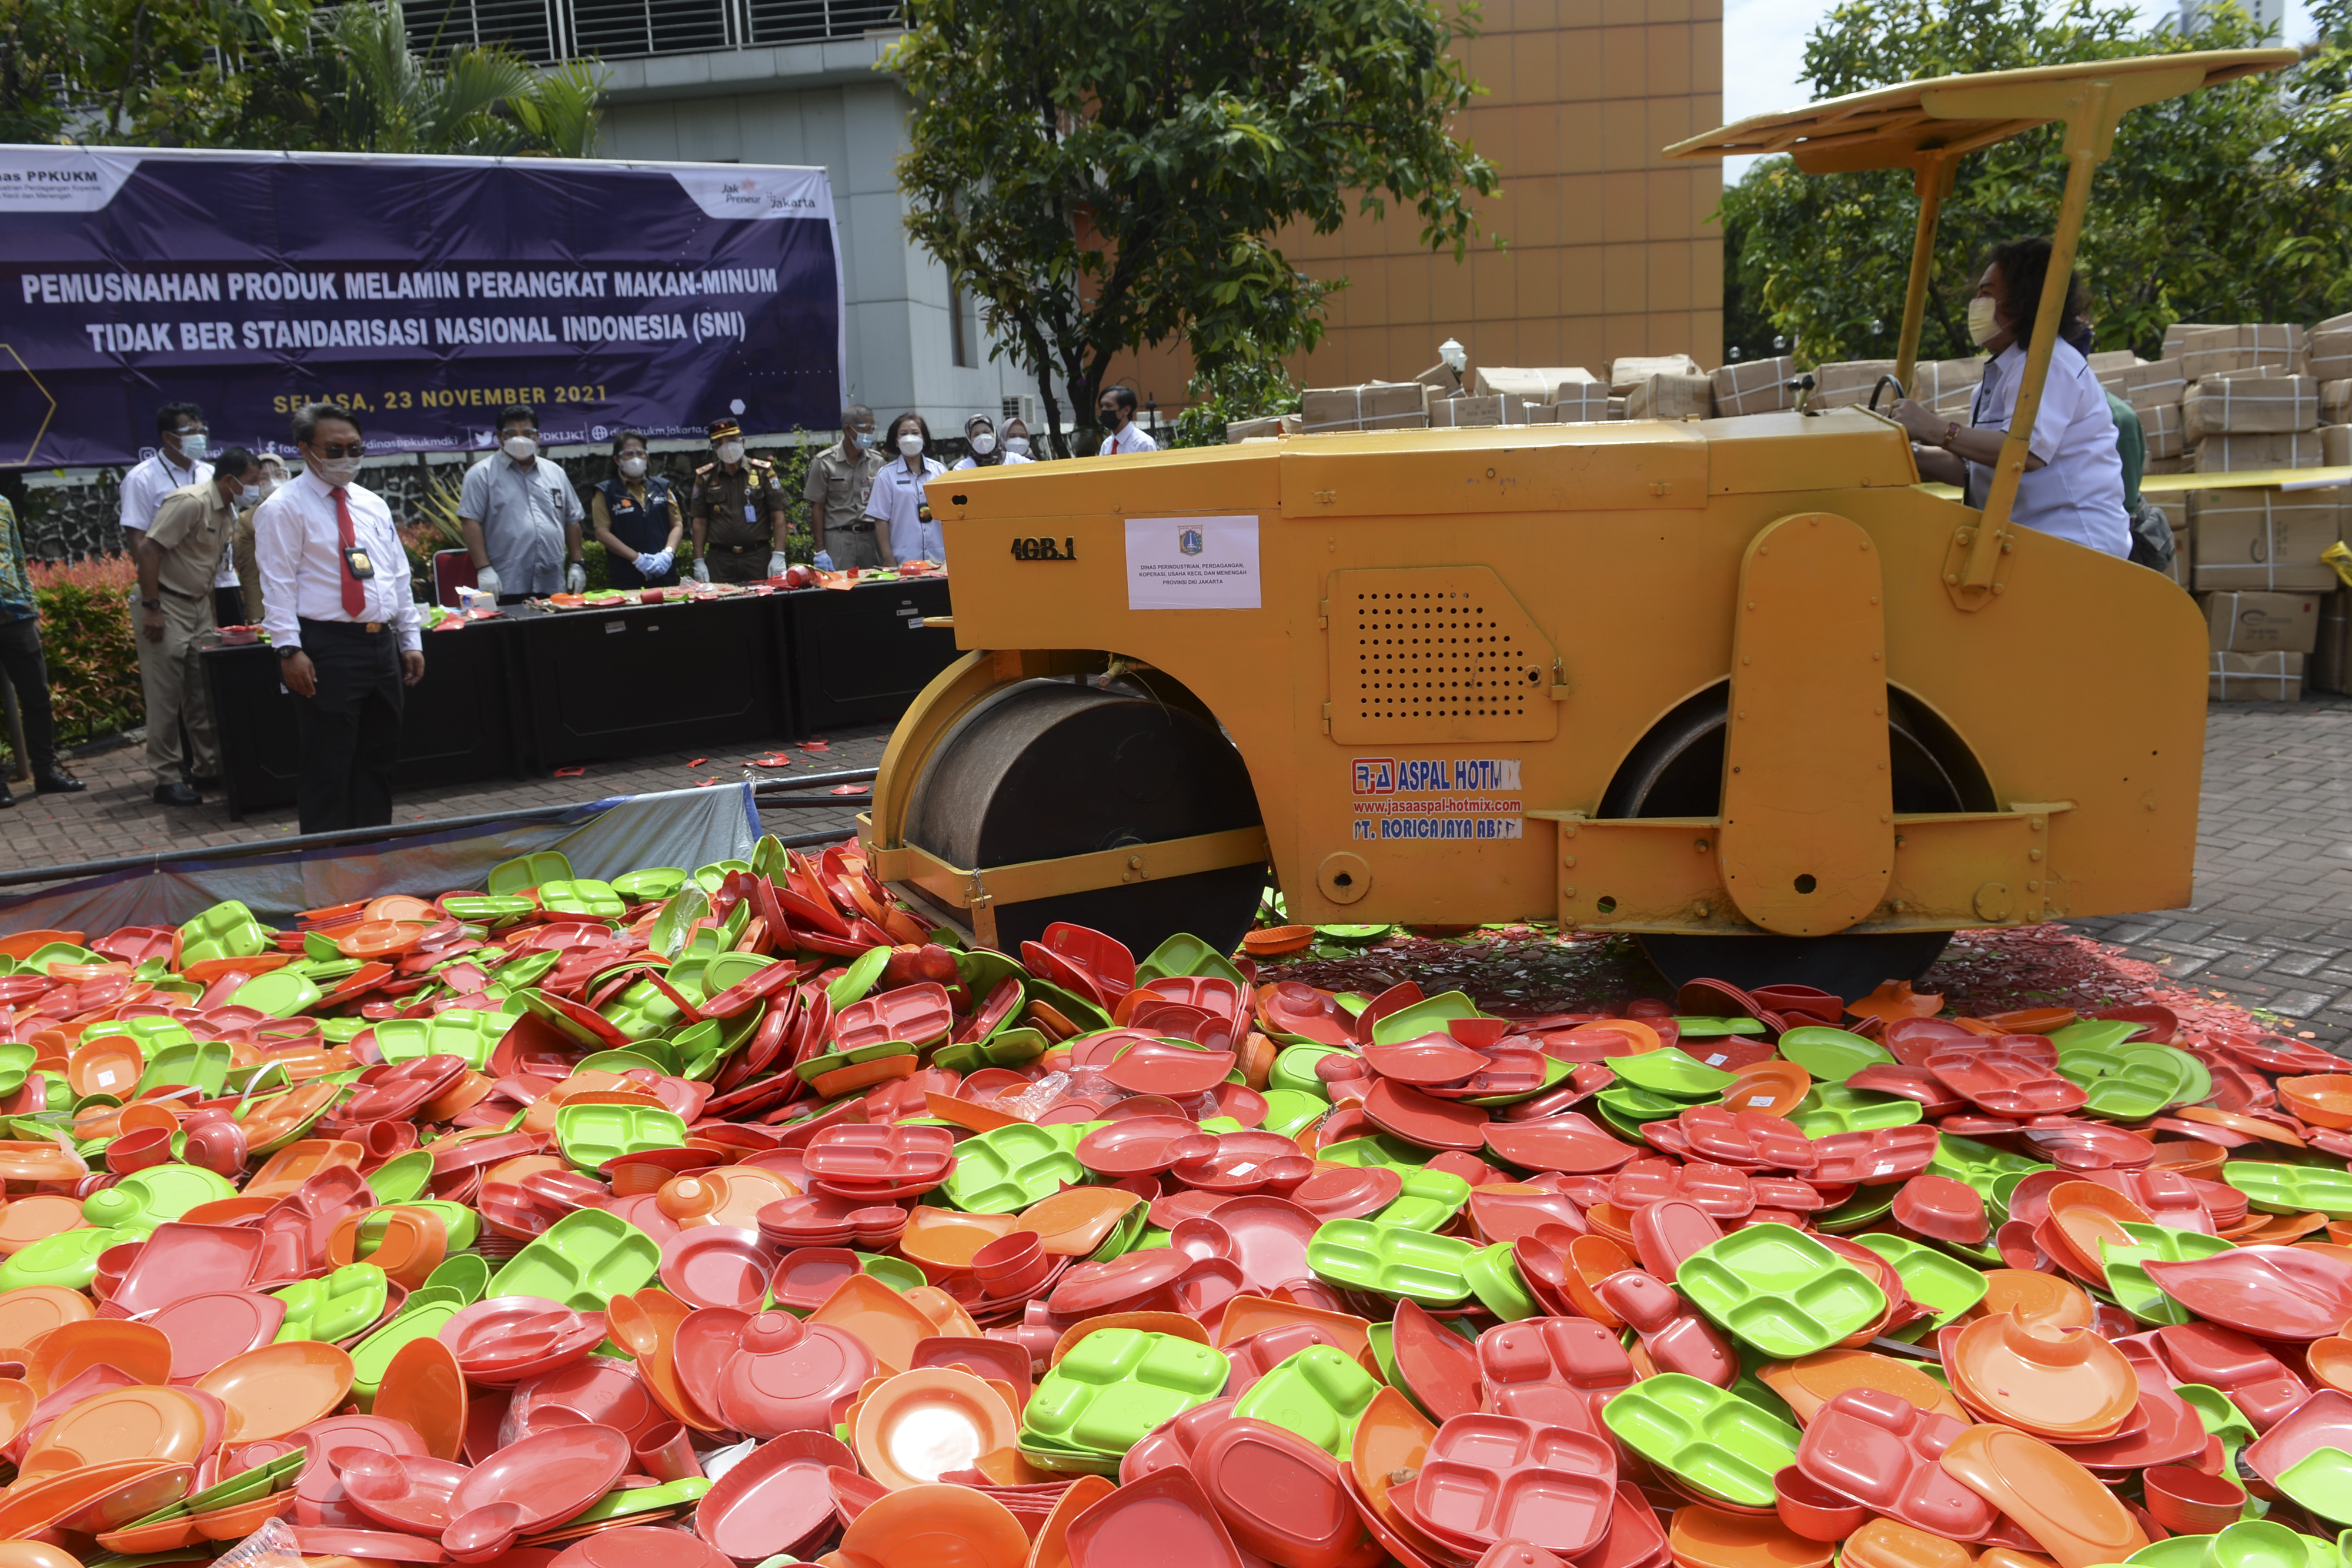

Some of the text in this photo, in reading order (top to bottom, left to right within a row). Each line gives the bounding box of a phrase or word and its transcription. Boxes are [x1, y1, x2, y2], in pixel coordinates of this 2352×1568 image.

[0, 171, 98, 181] as PPKUKM
[722, 184, 739, 193] Jak
[726, 194, 761, 203] Preneur
[771, 198, 816, 208] Jakarta
[21, 268, 777, 303] PEMUSNAHAN PRODUK MELAMIN PERANGKAT MAKAN-MINUM
[86, 310, 746, 353] TIDAK BER STANDARISASI NASIONAL INDONESIA (SNI)
[384, 392, 412, 409] 23
[421, 387, 546, 407] NOVEMBER
[554, 385, 606, 402] 2021
[1397, 761, 1451, 791] ASPAL
[1353, 797, 1522, 816] www.jasaaspal-hotmix.com
